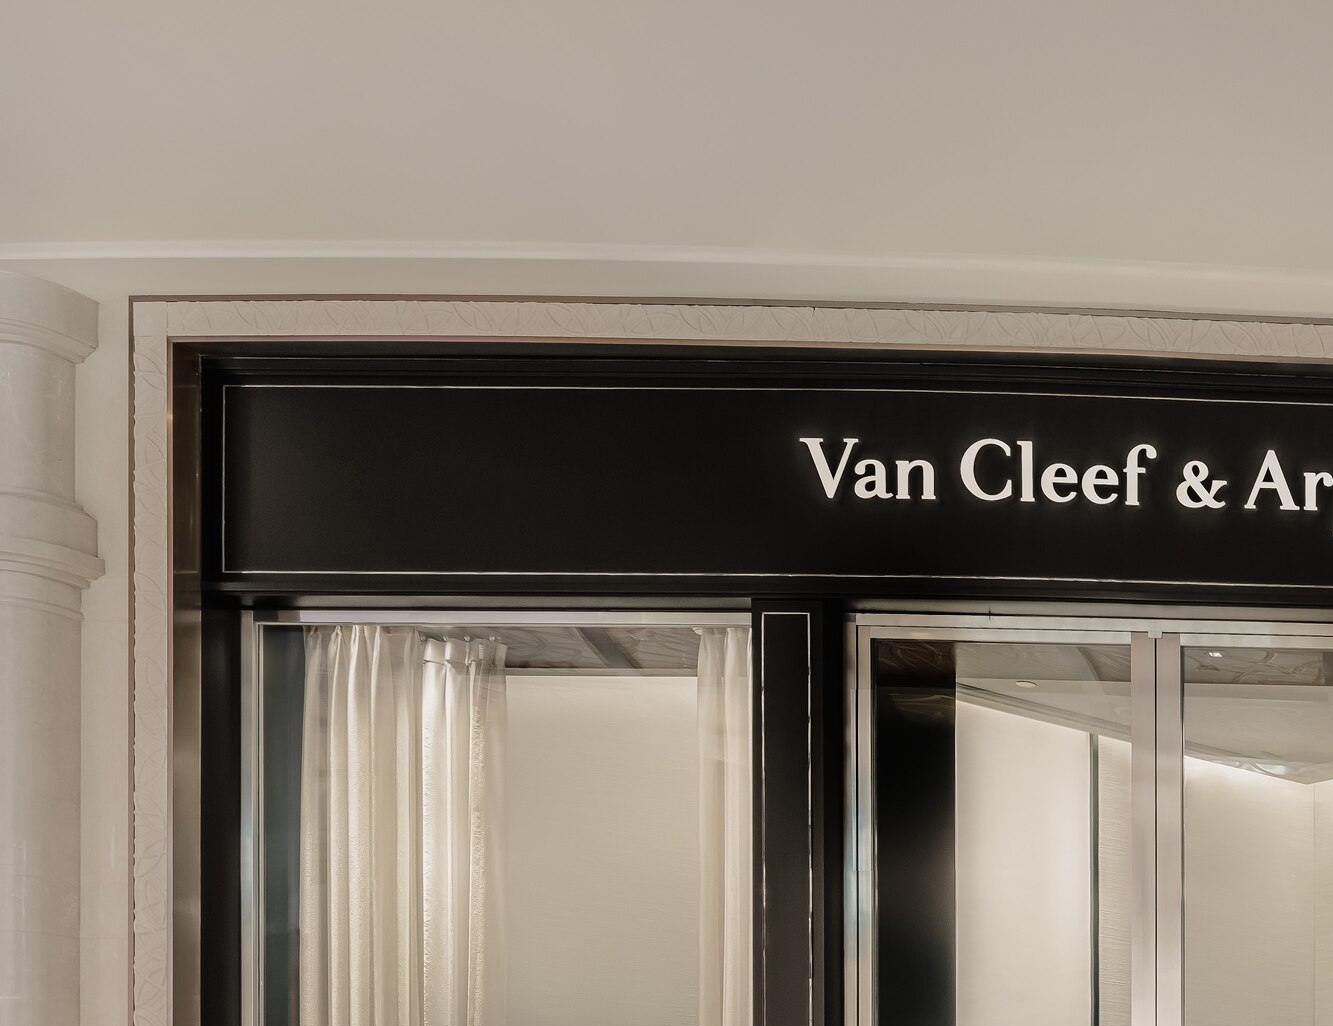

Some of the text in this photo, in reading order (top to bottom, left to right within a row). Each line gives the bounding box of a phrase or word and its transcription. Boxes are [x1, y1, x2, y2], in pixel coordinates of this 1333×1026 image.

[799, 438, 937, 500] Van
[959, 438, 1158, 506] Cleef
[1175, 460, 1228, 509] &
